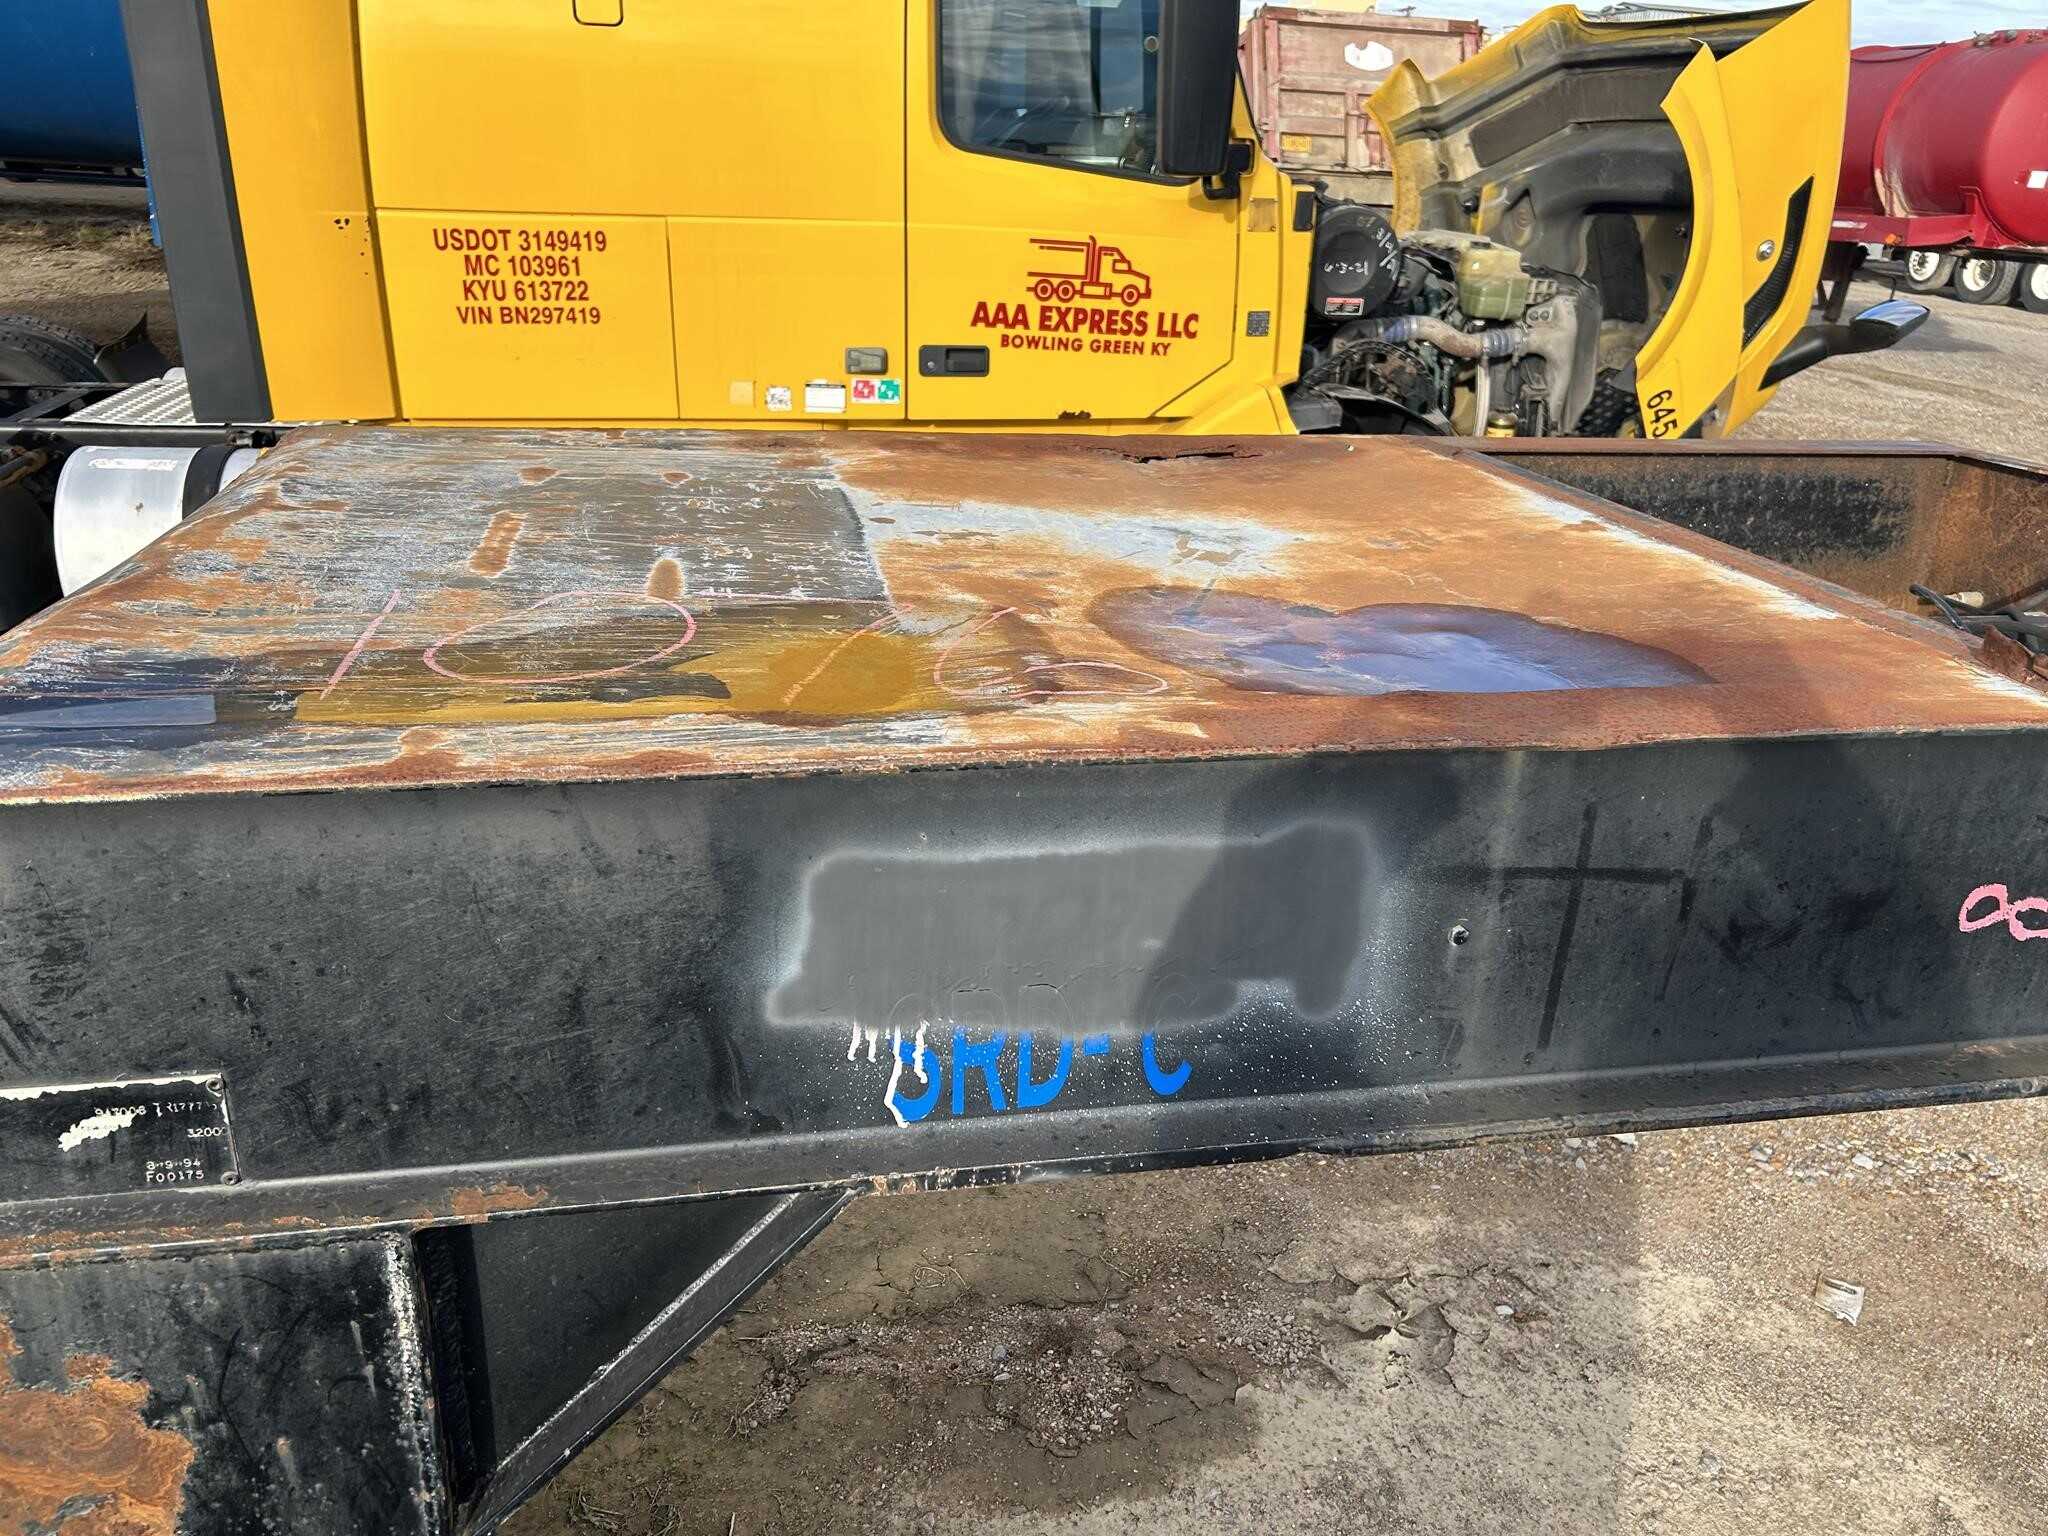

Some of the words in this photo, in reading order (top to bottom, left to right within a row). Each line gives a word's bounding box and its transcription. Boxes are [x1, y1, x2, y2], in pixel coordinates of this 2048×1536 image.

[433, 228, 511, 251] USDOT
[518, 230, 607, 252] 3149419
[464, 255, 500, 276] MC
[508, 255, 581, 276] 103961
[463, 280, 507, 301] KYU
[514, 281, 590, 301] 613722
[456, 306, 493, 325] VIN
[500, 307, 601, 325] BN297419
[970, 301, 1030, 330] AAA
[1039, 305, 1149, 338] EXPRESS
[1156, 312, 1199, 339] LLC
[1000, 334, 1083, 352] BOWLING
[1089, 339, 1144, 355] GREEN
[1151, 342, 1171, 356] KY
[1647, 389, 1677, 438] 645
